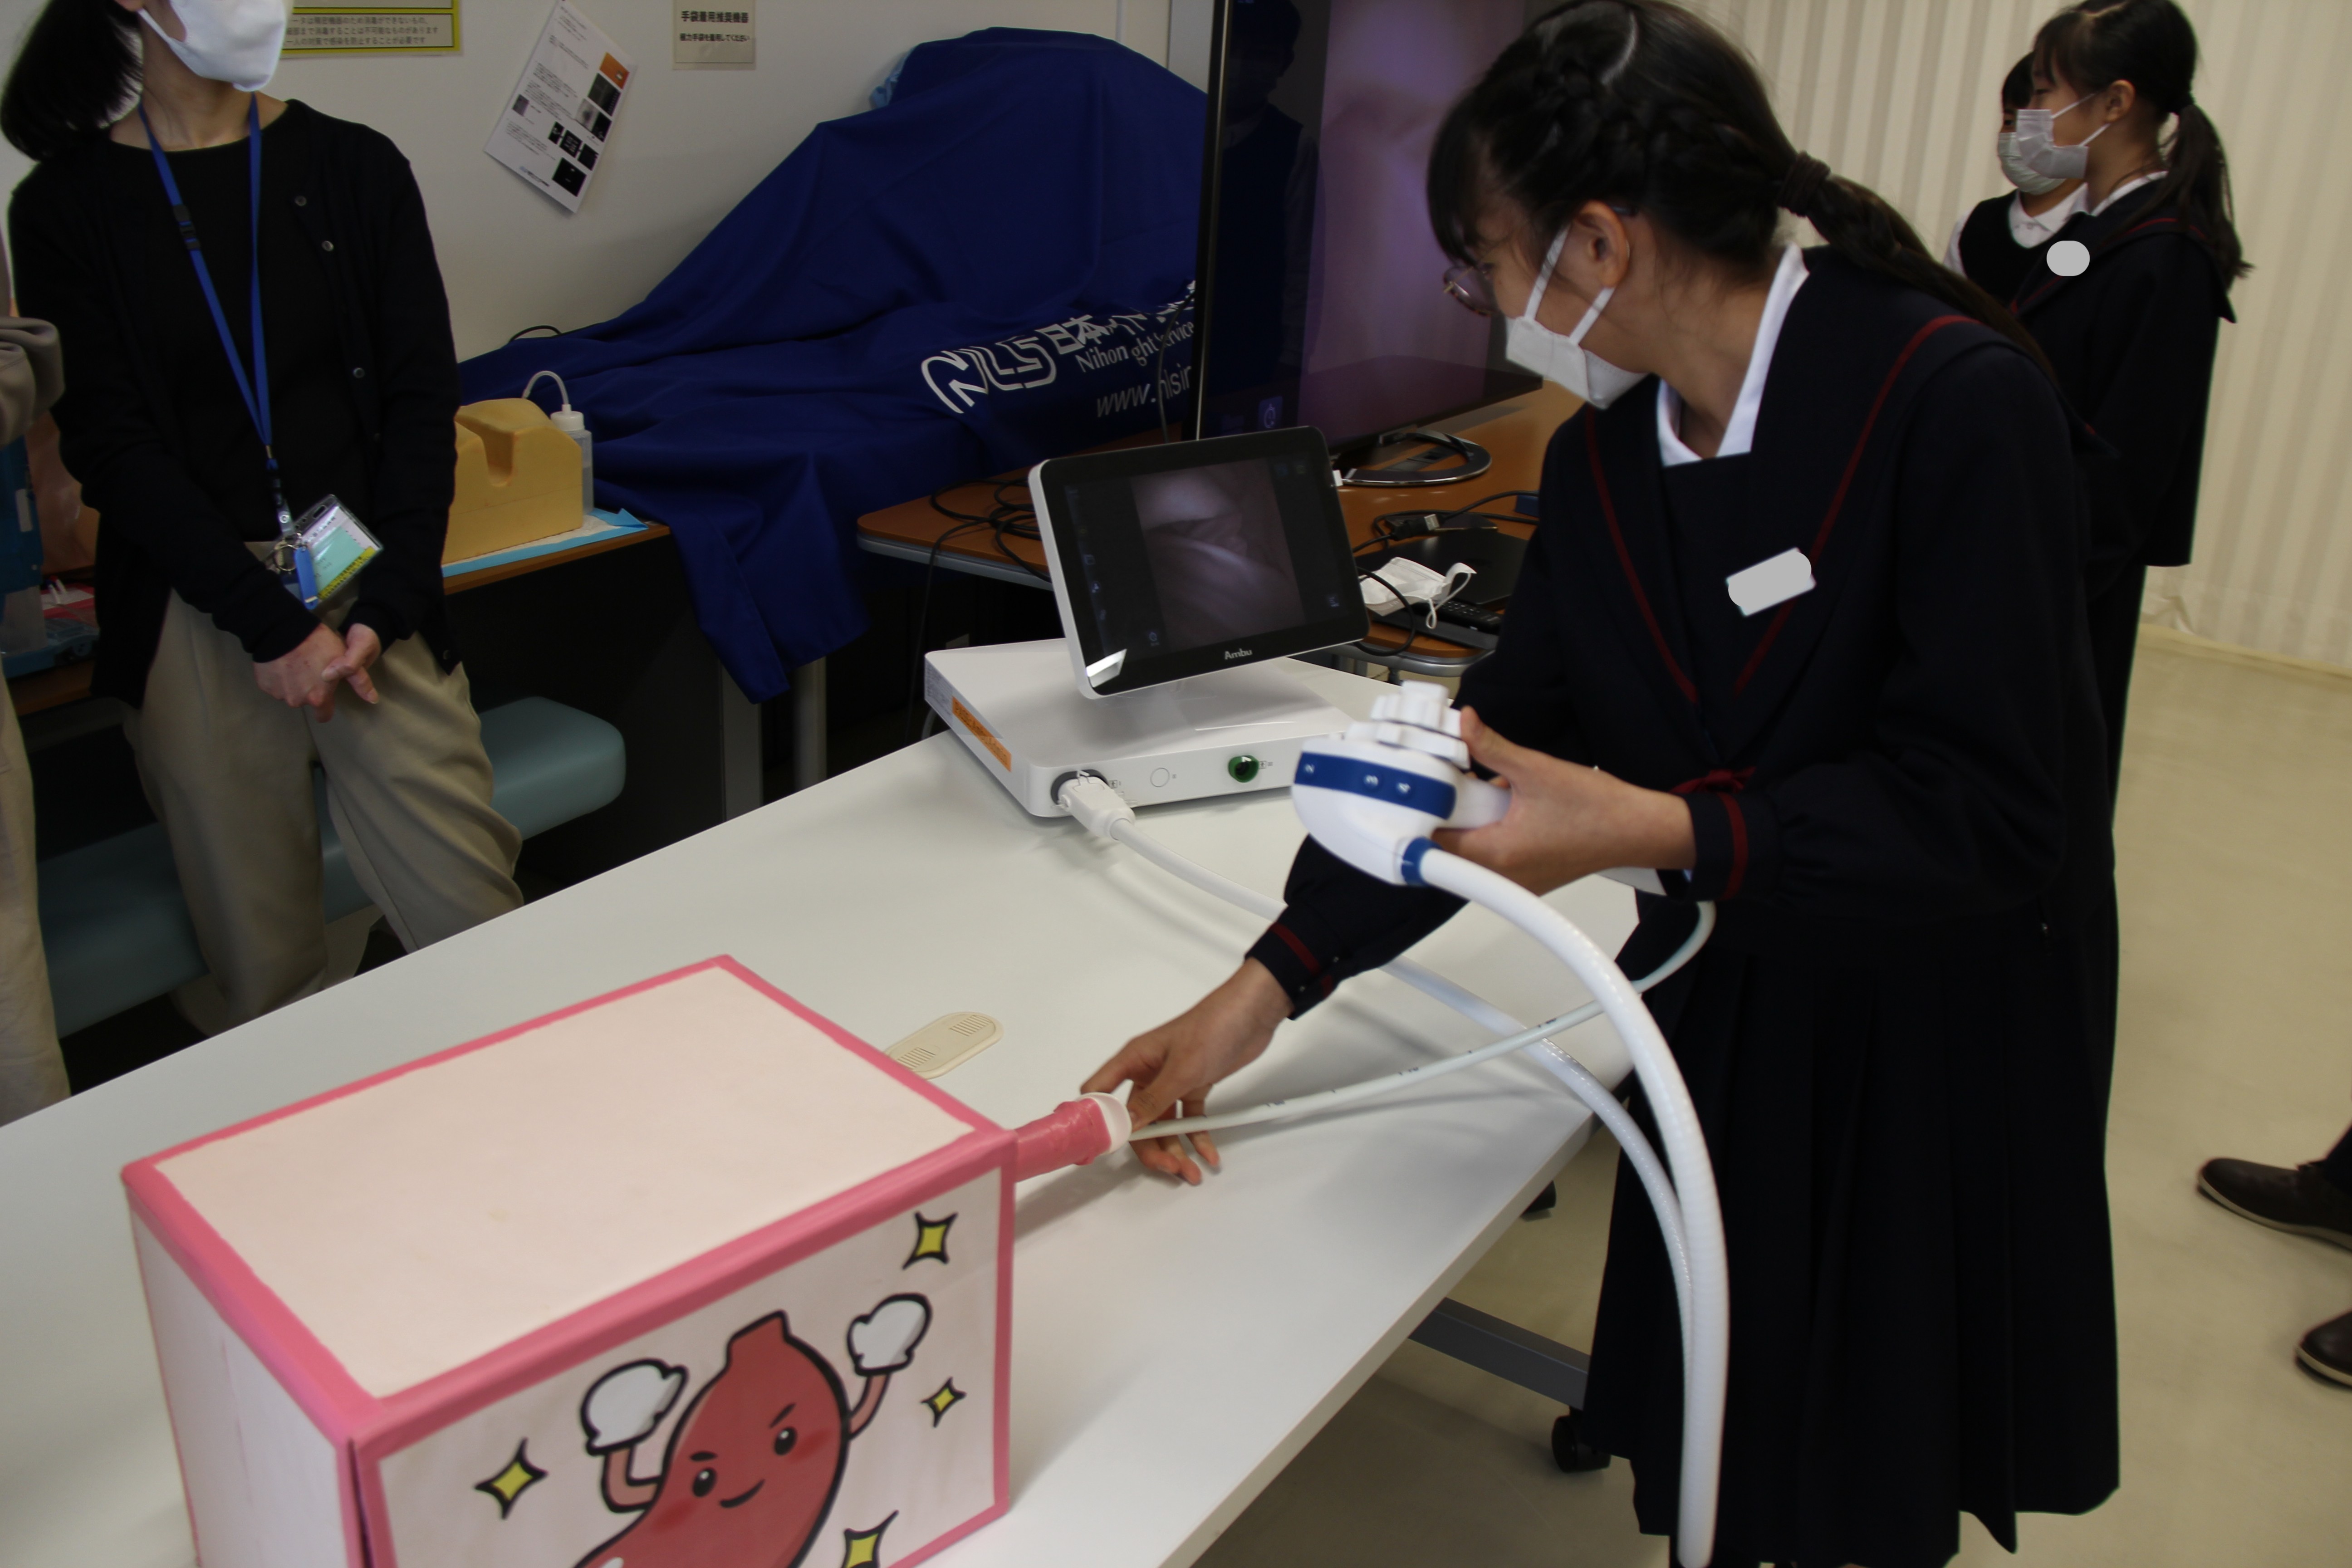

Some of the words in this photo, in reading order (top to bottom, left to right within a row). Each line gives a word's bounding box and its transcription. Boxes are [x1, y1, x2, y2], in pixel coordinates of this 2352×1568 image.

[1075, 346, 1129, 372] Nihon
[1131, 336, 1159, 366] ght
[1224, 648, 1253, 660] Ambu
